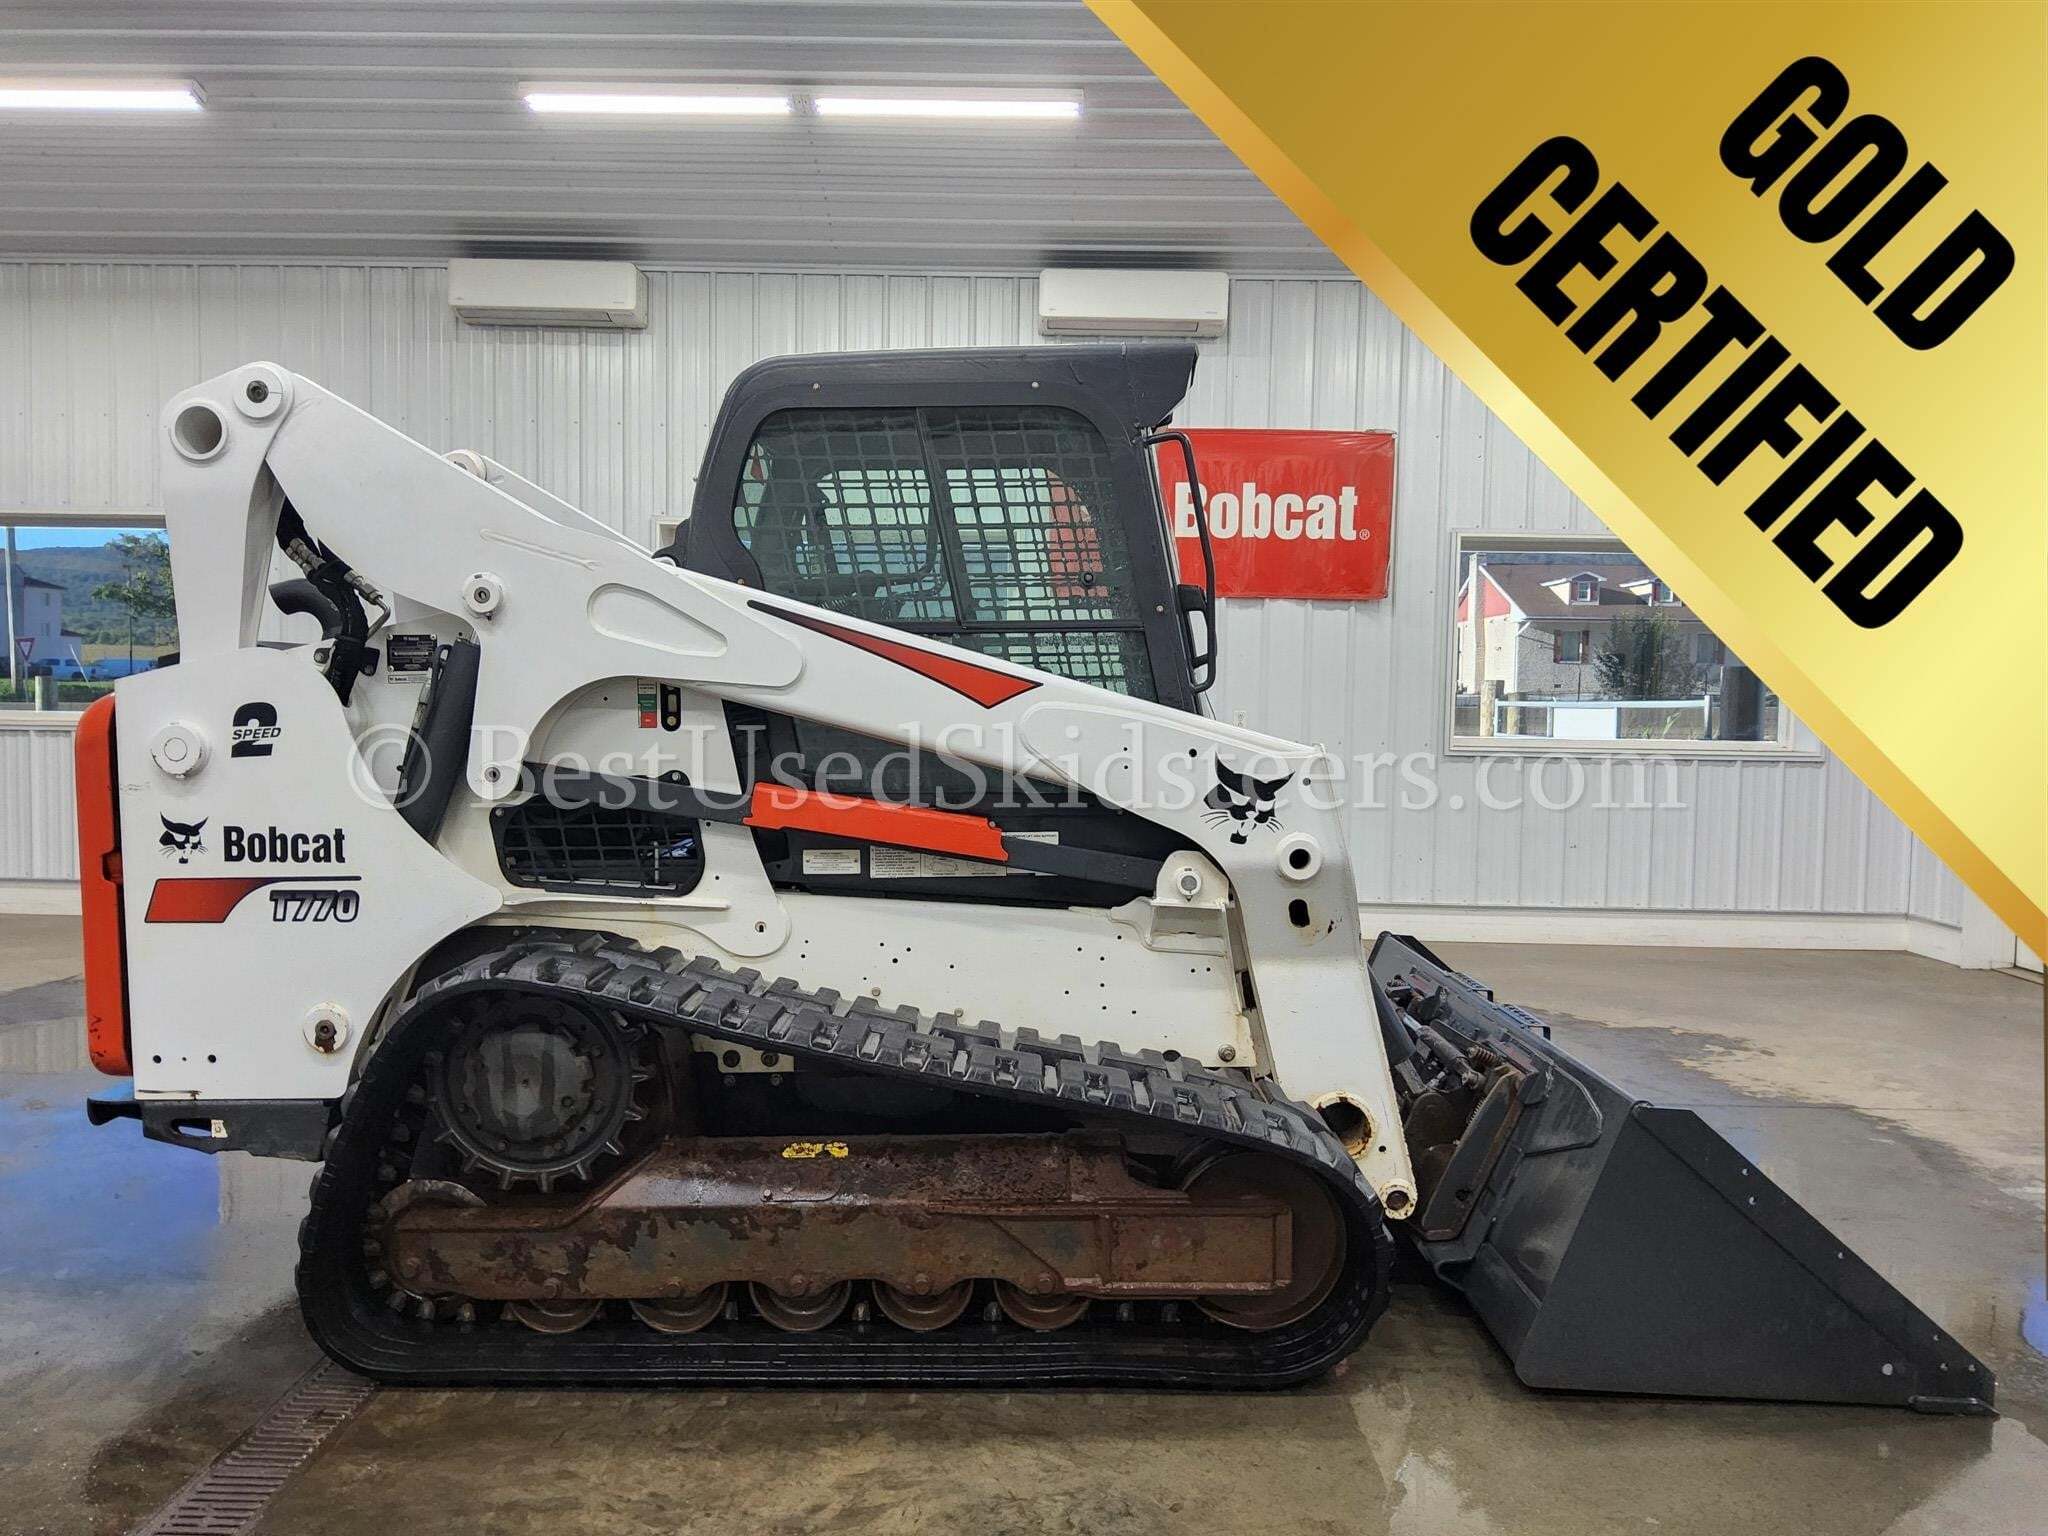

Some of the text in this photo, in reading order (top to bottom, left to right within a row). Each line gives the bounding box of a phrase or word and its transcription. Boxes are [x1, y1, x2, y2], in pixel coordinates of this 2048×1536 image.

[231, 701, 278, 758] 2
[231, 727, 282, 741] SPEED
[223, 825, 346, 864] Bobcat
[269, 889, 360, 923] T770
